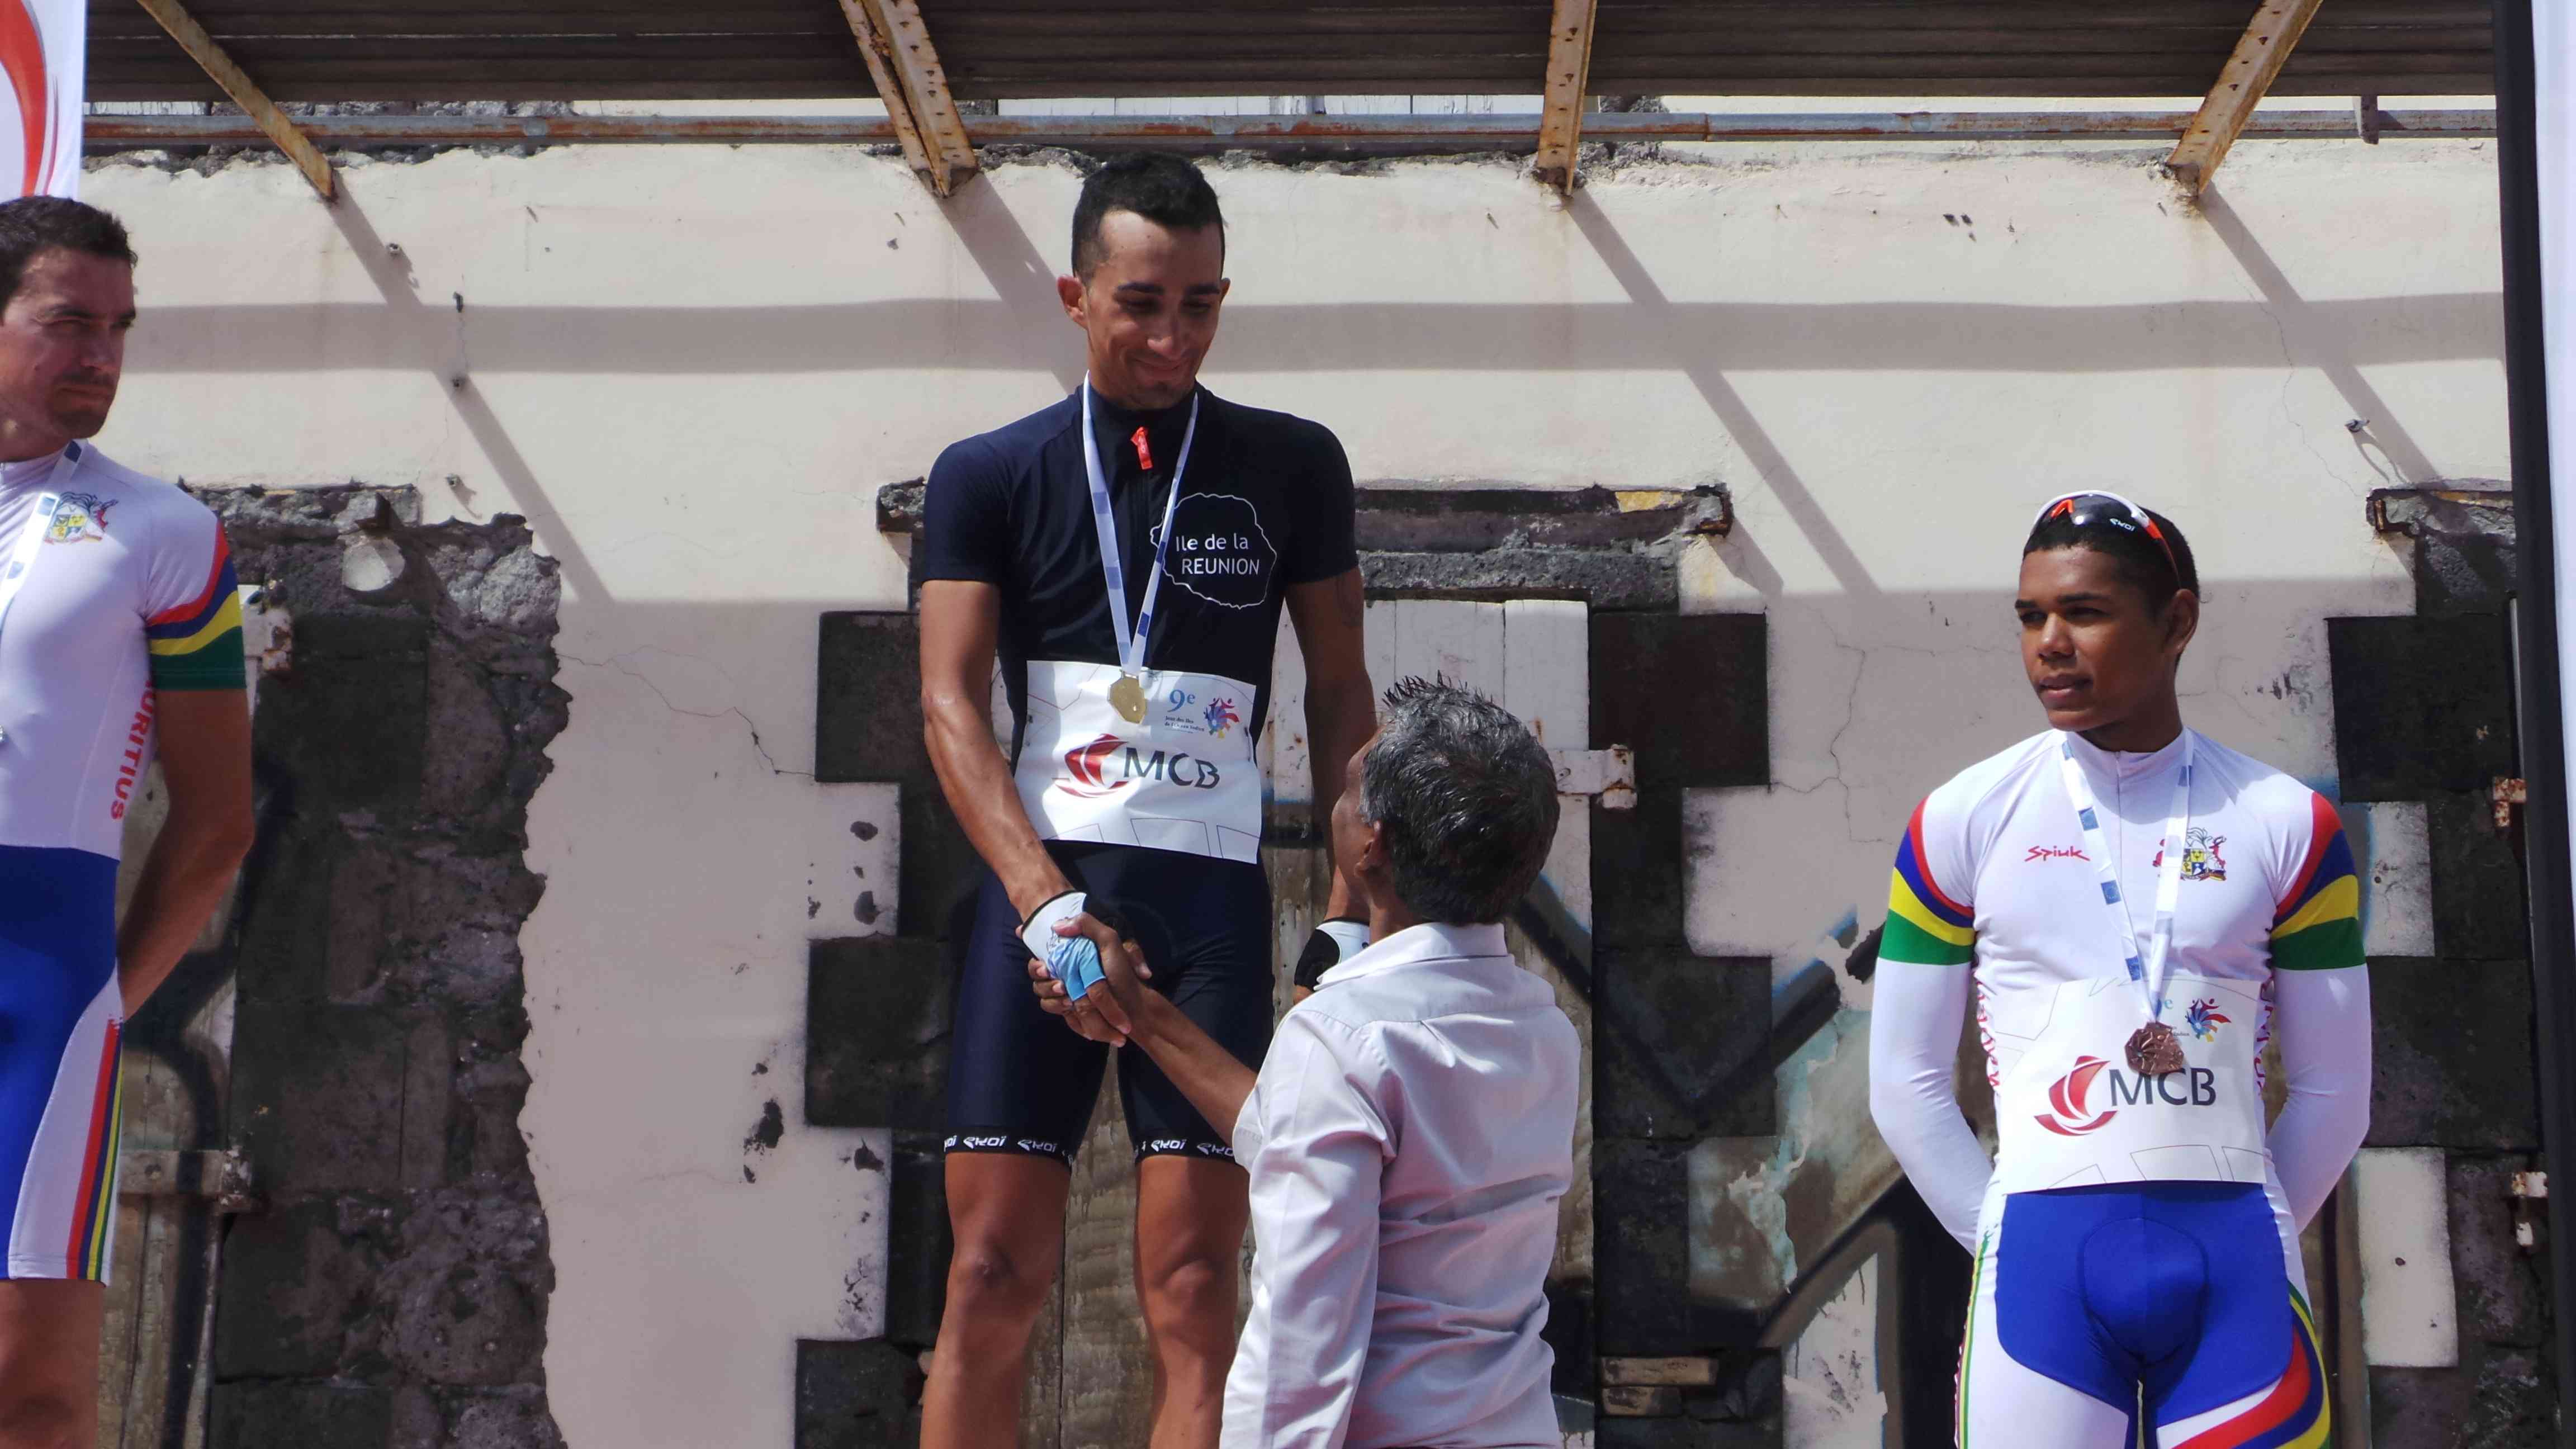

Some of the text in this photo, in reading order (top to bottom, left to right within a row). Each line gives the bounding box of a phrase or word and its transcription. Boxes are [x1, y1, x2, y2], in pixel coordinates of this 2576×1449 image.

[1176, 532, 1248, 552] Ile de la
[1182, 558, 1259, 575] REUNION
[111, 680, 154, 820] URITIUS
[1123, 747, 1220, 789] MCB
[2024, 845, 2091, 862] Spiuk
[2109, 1067, 2217, 1107] MCB
